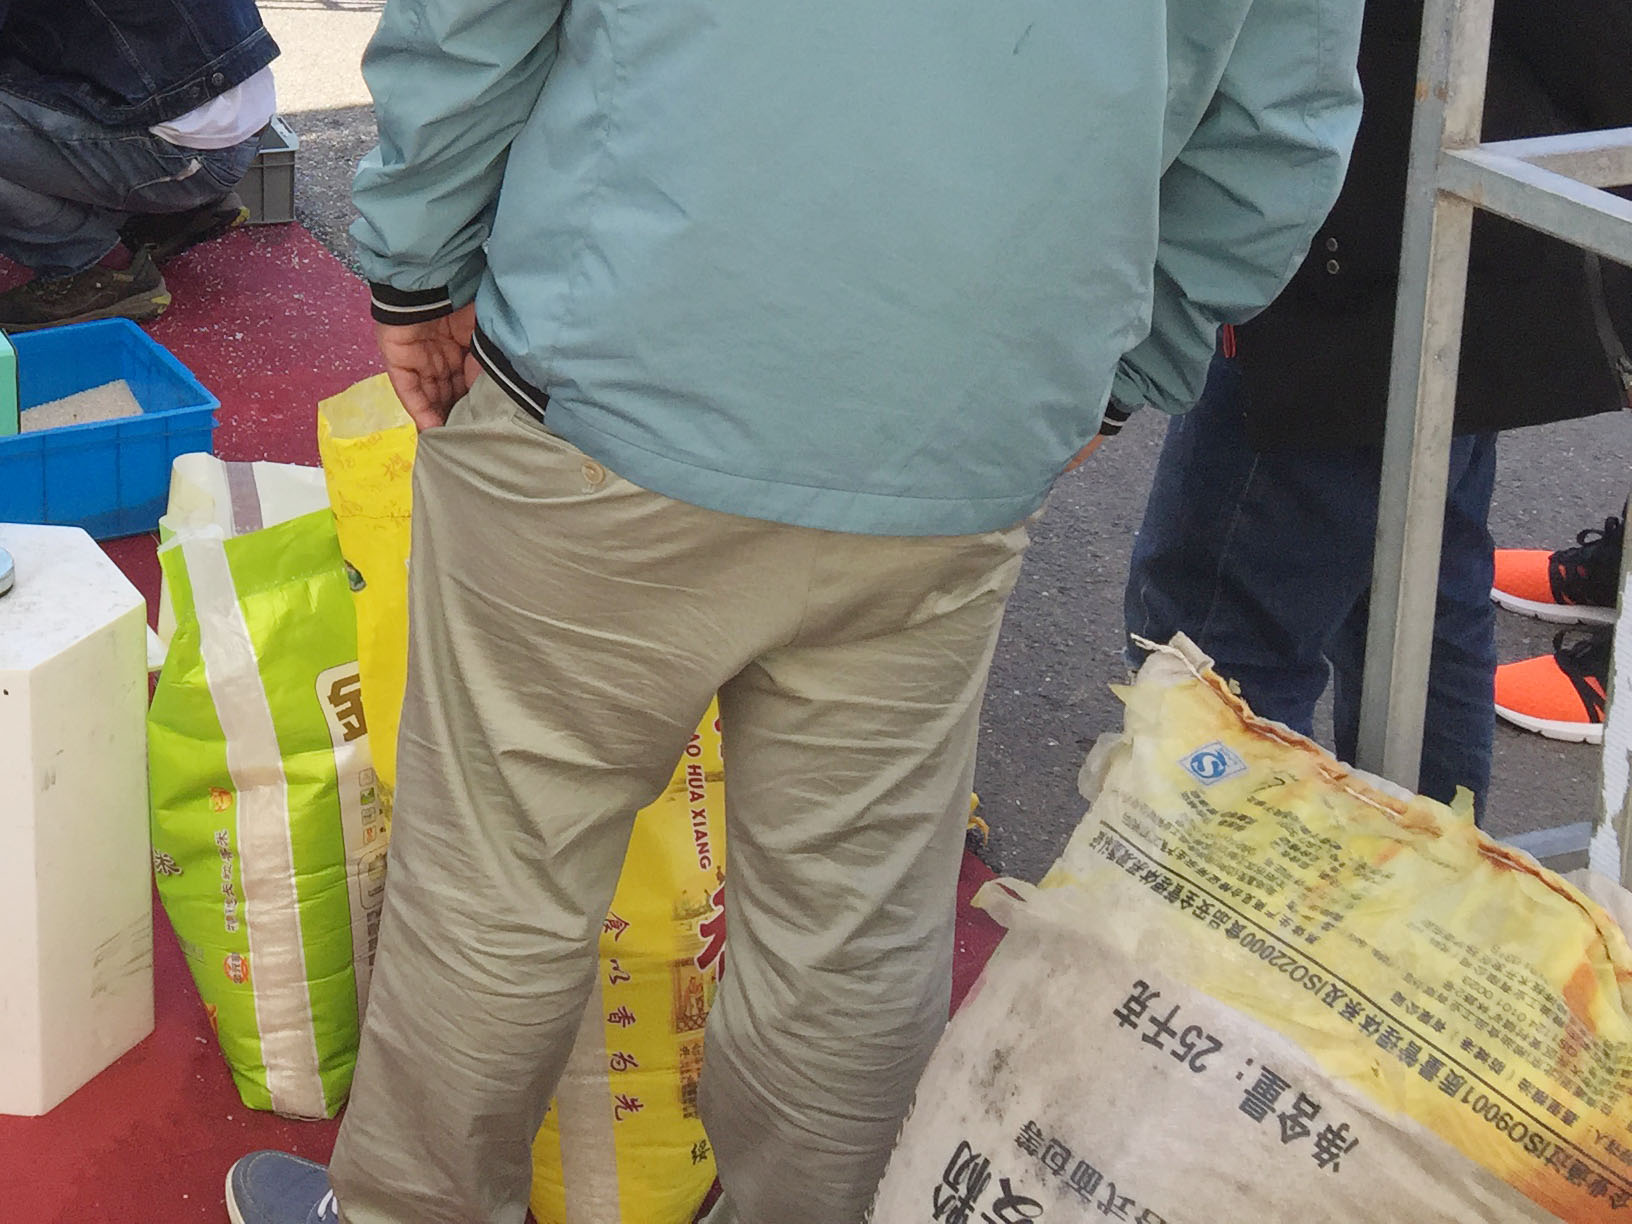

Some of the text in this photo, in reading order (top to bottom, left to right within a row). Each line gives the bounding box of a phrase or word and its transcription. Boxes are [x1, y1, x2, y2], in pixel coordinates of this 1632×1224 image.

[687, 763, 706, 804] HUA
[690, 808, 713, 871] XIANG
[1112, 979, 1359, 1173] 净含量：25千克
